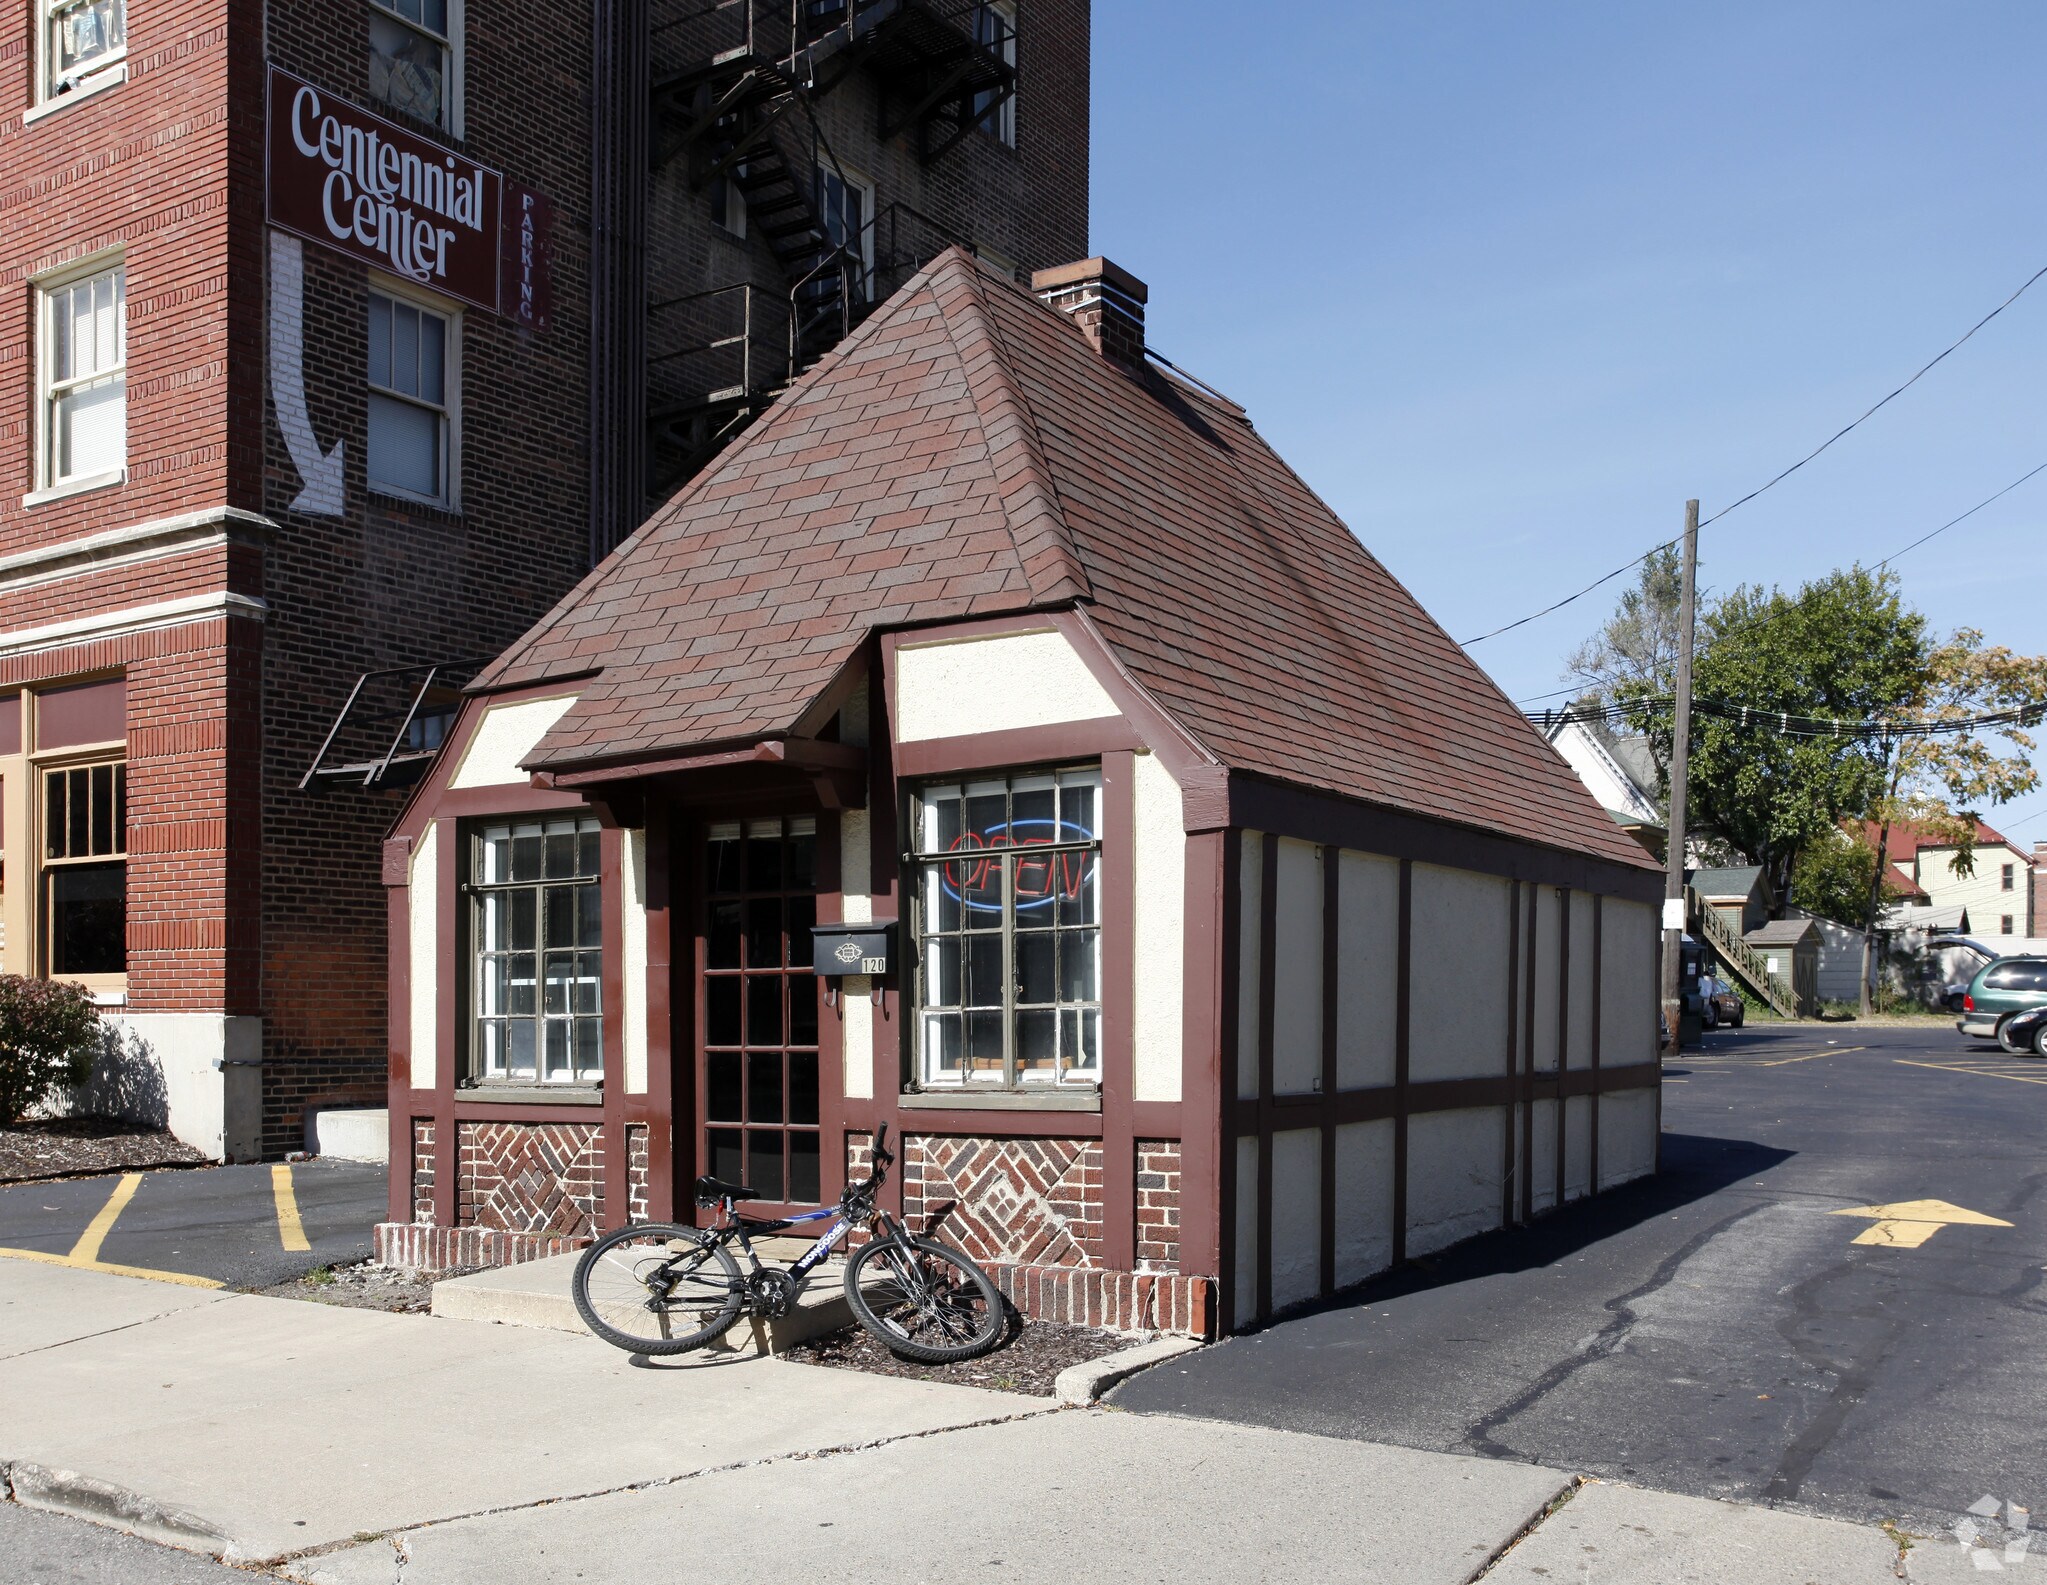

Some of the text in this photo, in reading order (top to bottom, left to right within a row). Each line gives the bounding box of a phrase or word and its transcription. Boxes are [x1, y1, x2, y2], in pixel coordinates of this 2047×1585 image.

[291, 86, 483, 232] Centennial
[323, 170, 456, 283] Center
[520, 193, 534, 320] PARKING
[945, 832, 1087, 899] OPEN
[863, 958, 885, 973] 120
[797, 1222, 846, 1268] MONGOOSE
